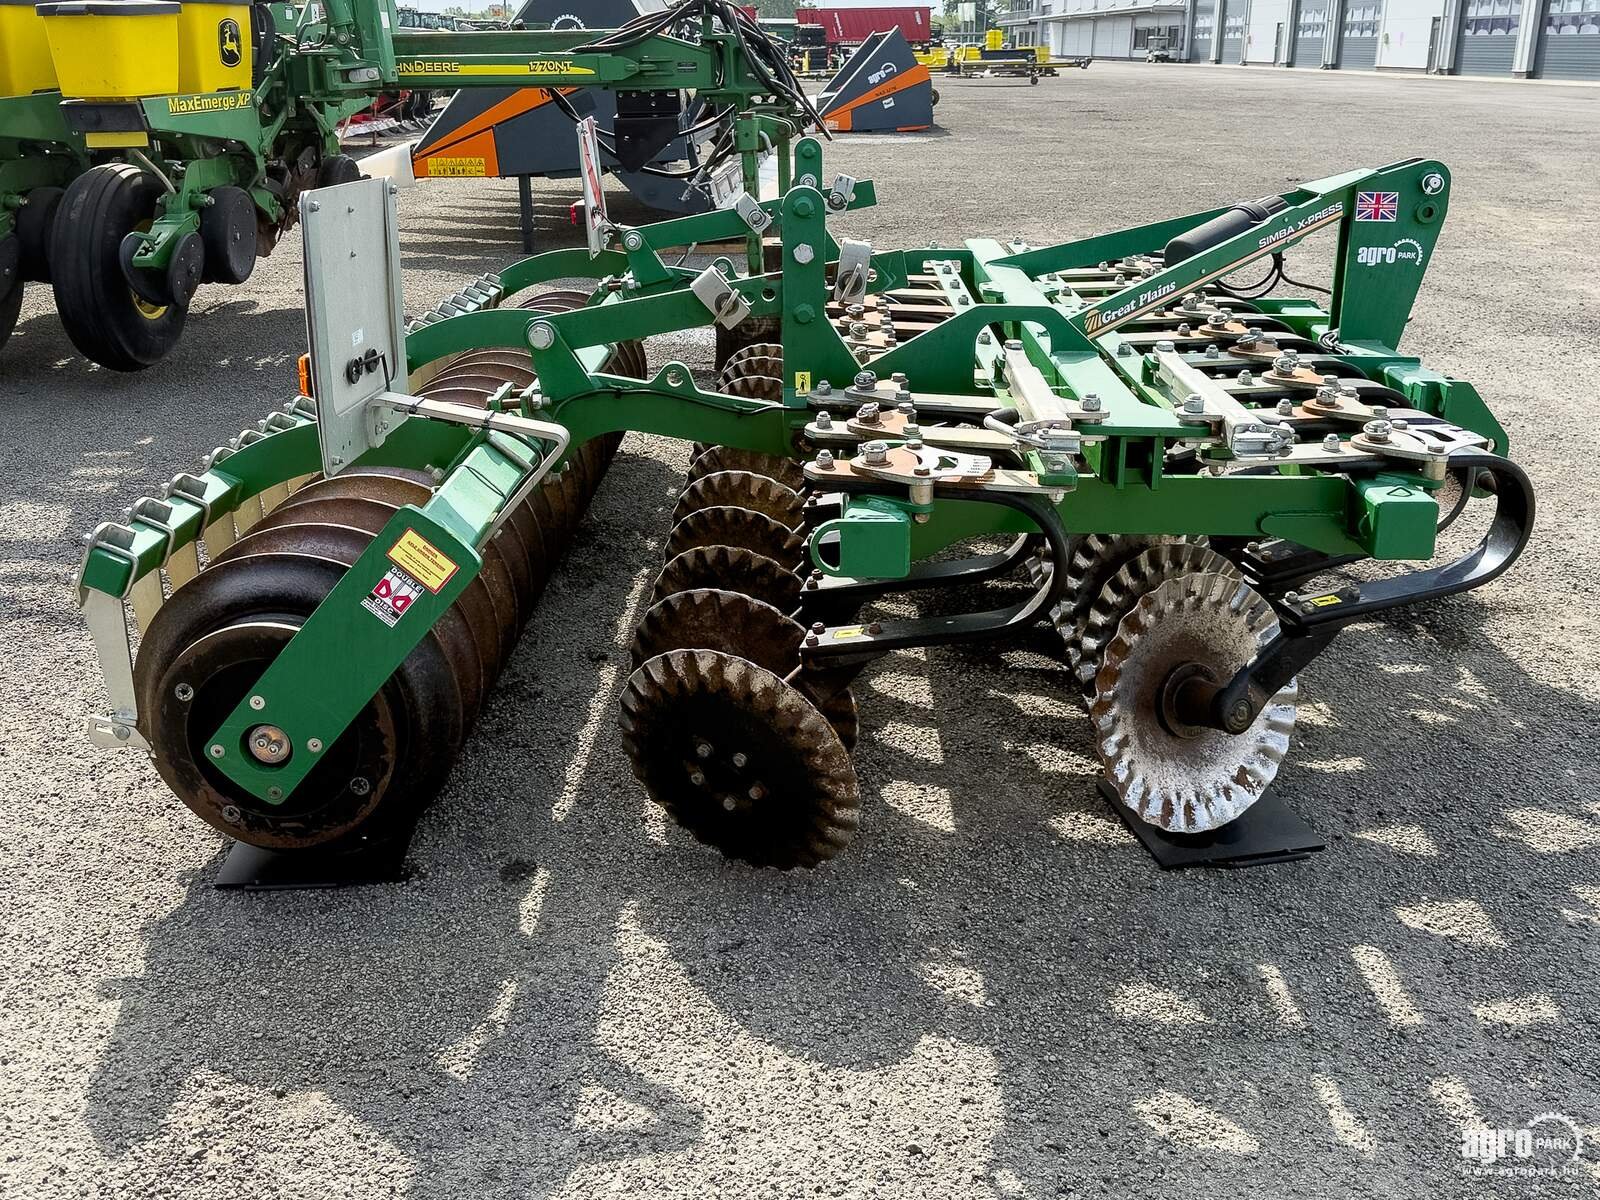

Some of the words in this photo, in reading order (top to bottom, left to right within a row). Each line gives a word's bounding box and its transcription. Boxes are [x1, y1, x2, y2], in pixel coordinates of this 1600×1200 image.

[395, 62, 412, 72] HN
[414, 60, 459, 72] DEERE
[528, 60, 574, 71] 1770NT
[168, 95, 235, 113] MaxEmerge
[236, 92, 251, 108] XP
[1258, 225, 1296, 248] SIMBA
[1297, 201, 1343, 230] X-PRESS
[1357, 246, 1397, 267] agro
[1397, 251, 1417, 259] PARK
[1101, 299, 1137, 324] Great
[1139, 281, 1176, 307] Plains
[391, 567, 422, 593] DOUBLE
[374, 598, 394, 614] DISC
